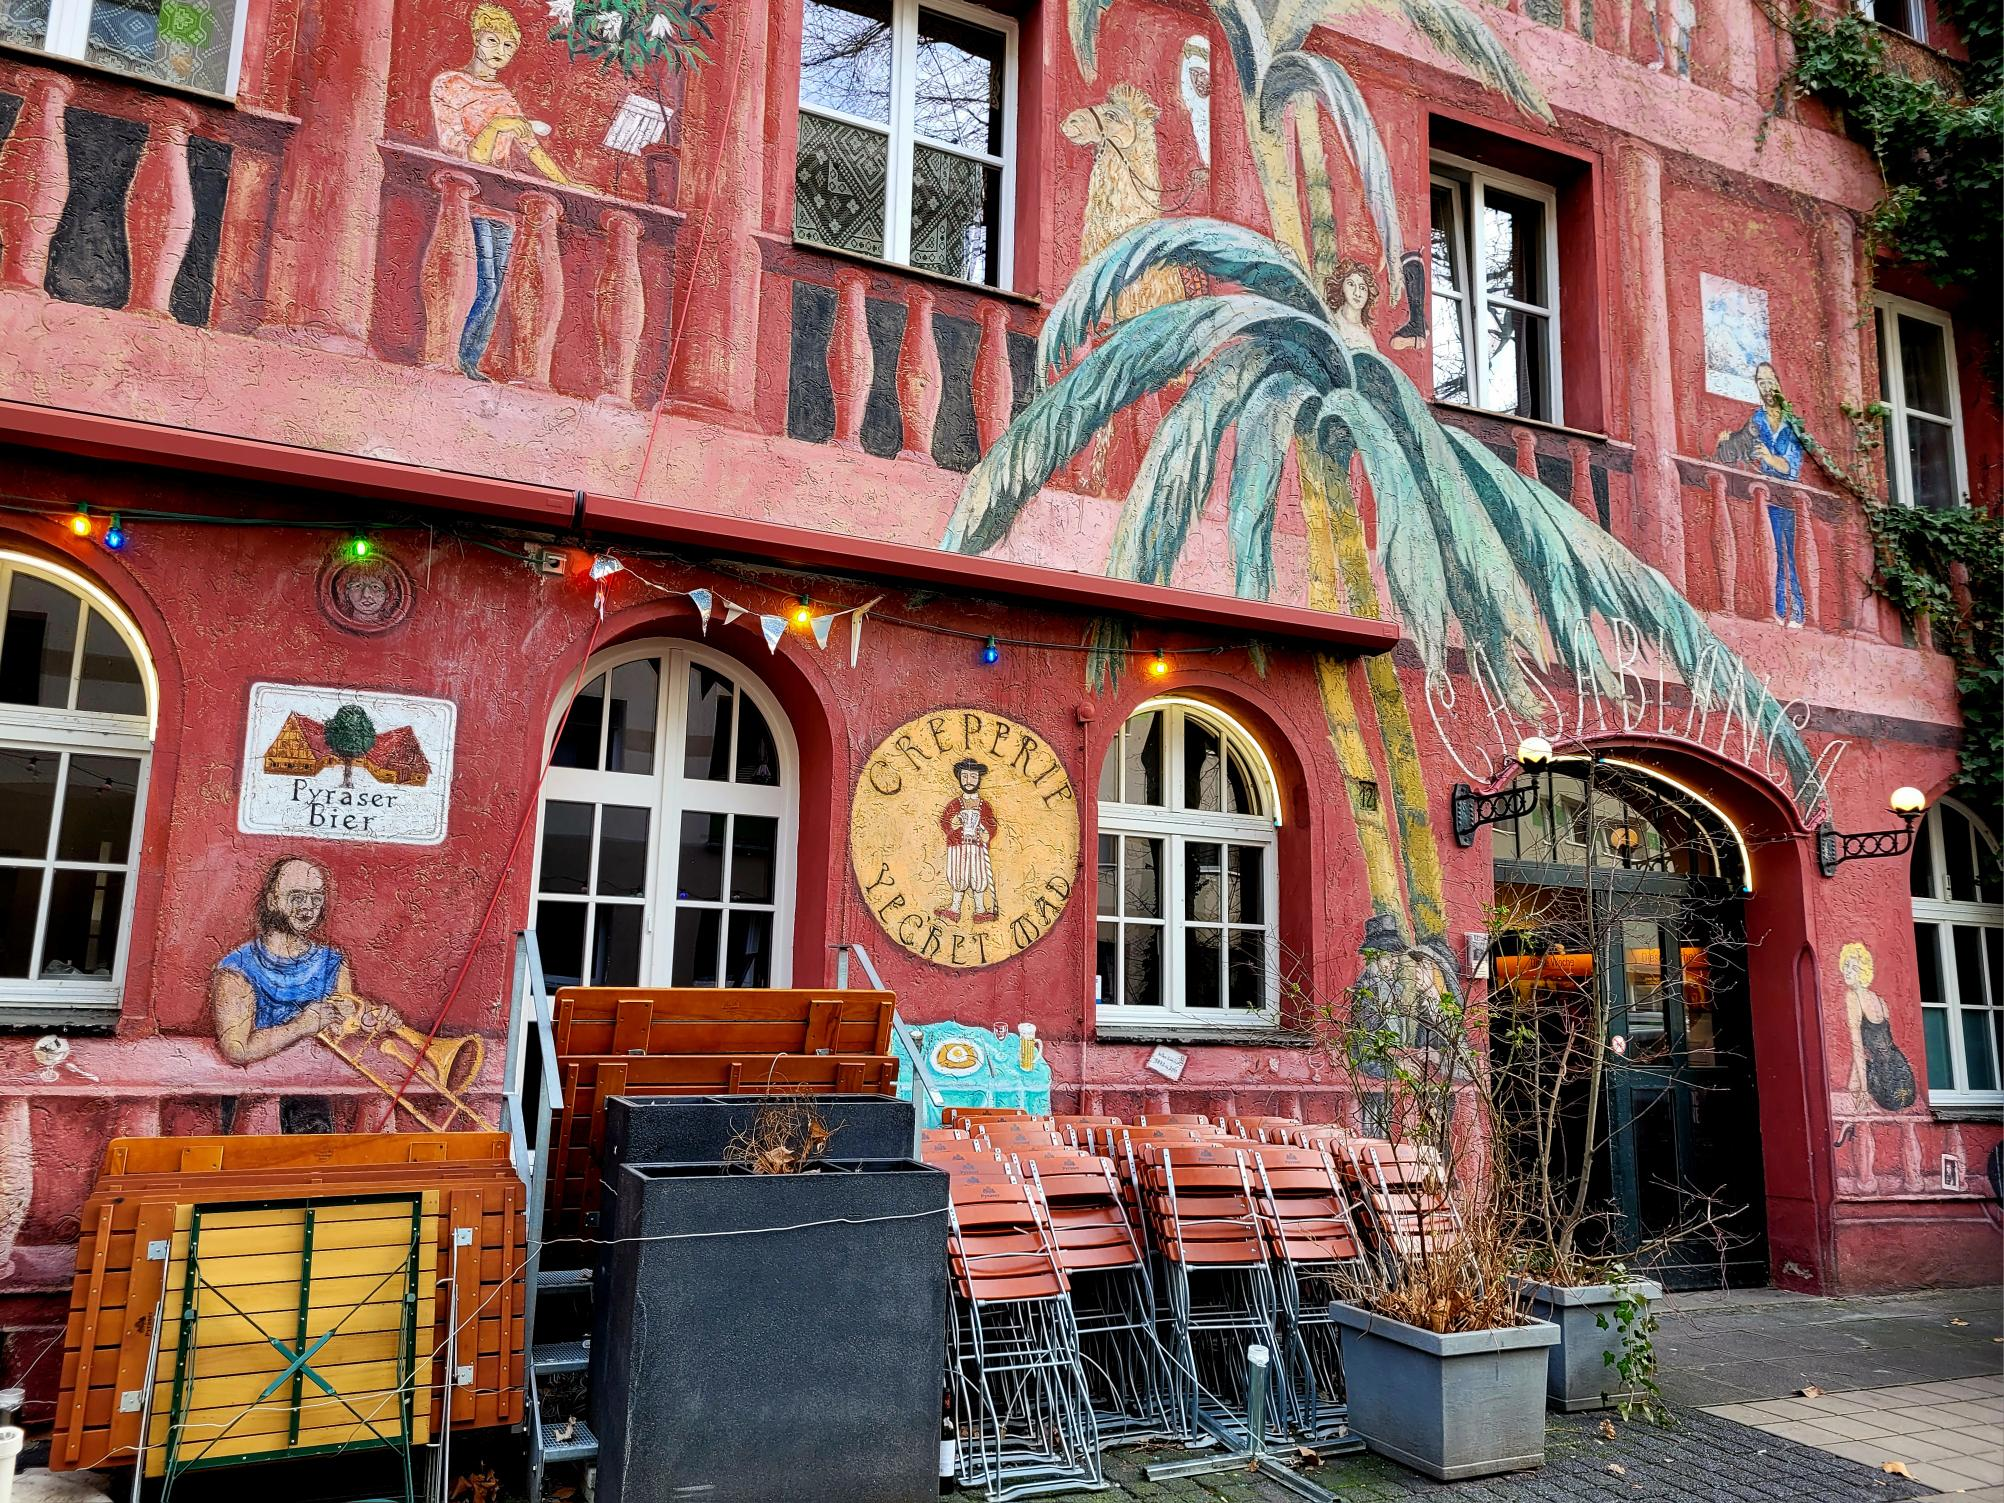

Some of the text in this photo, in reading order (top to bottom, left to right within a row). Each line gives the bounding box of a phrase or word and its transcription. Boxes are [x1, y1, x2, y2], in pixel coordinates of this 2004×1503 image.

[1424, 617, 1852, 824] CASABLANCA
[291, 778, 398, 808] Pyraser
[869, 713, 1072, 809] CREPERIE
[309, 802, 375, 831] Bier
[1010, 875, 1071, 949] MAD
